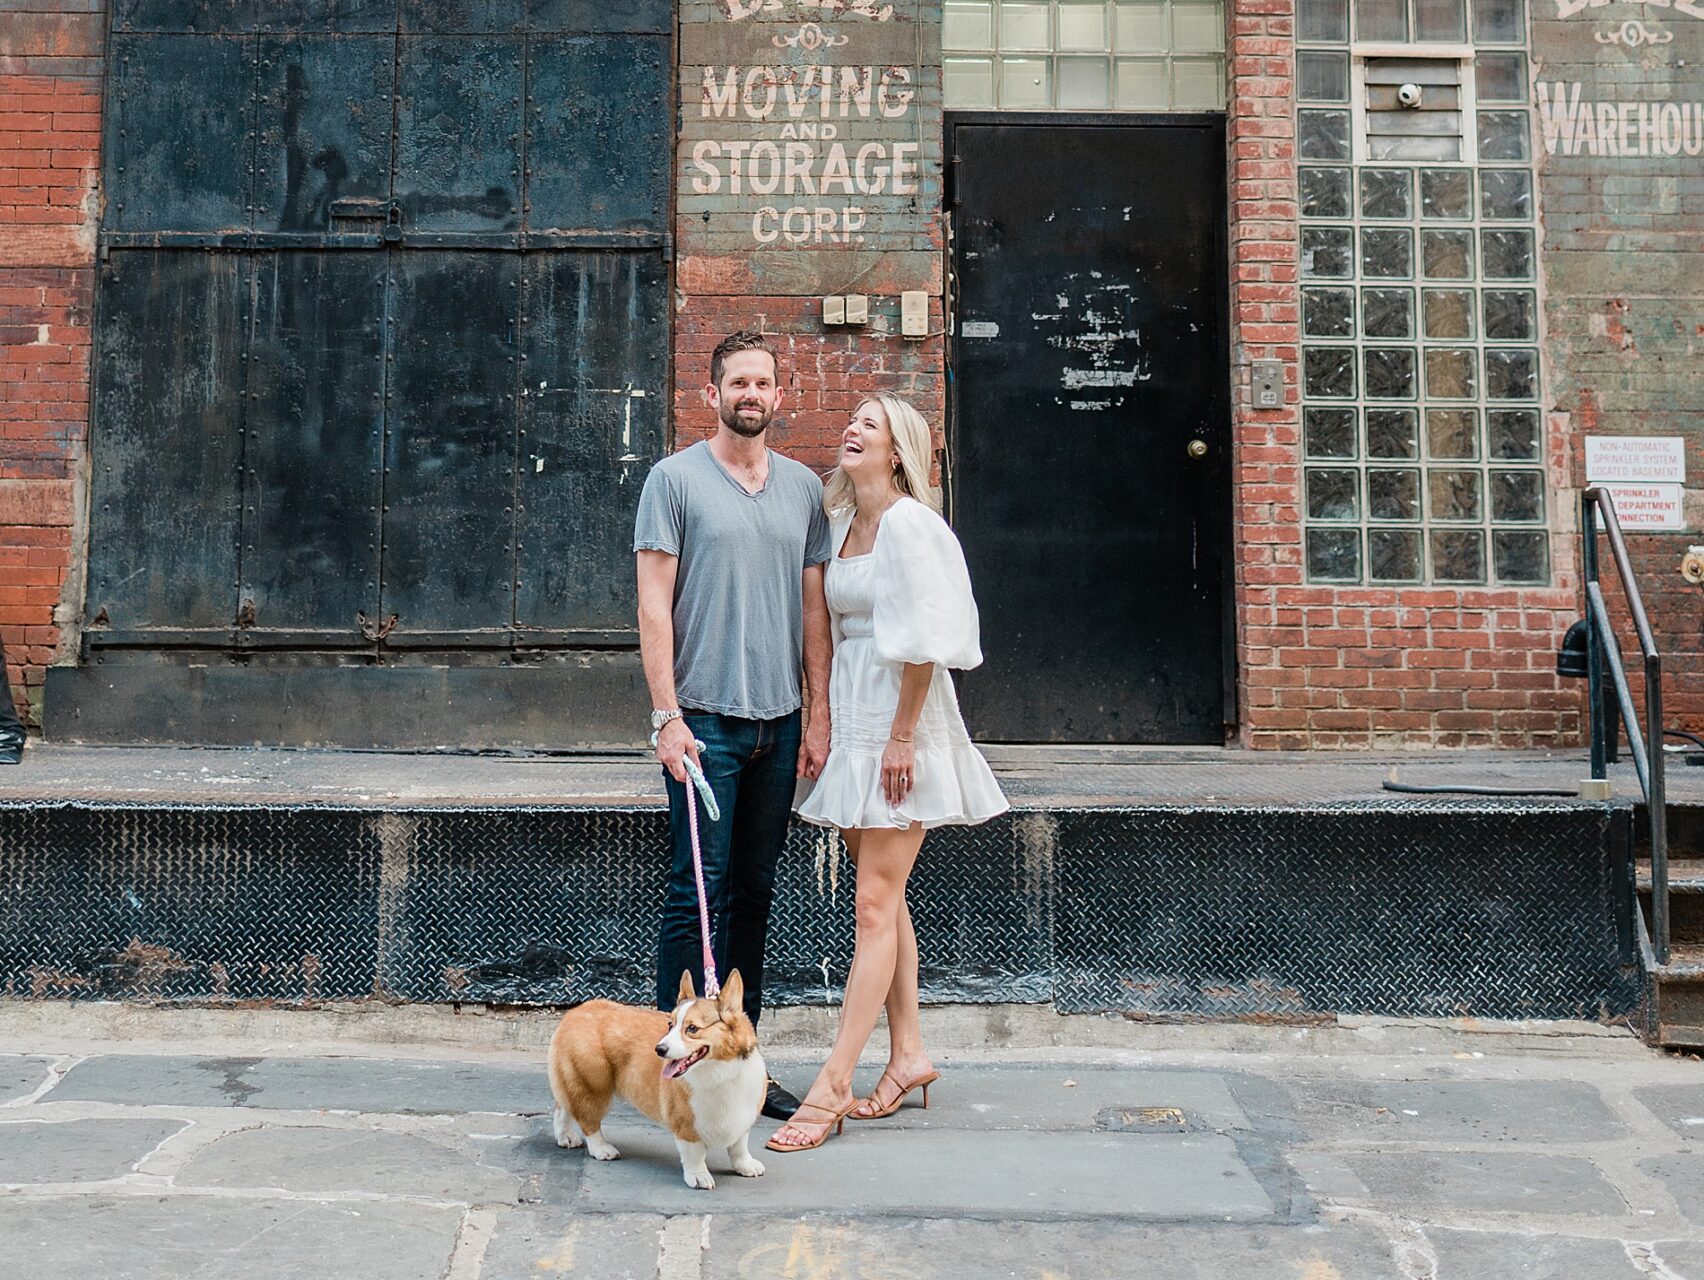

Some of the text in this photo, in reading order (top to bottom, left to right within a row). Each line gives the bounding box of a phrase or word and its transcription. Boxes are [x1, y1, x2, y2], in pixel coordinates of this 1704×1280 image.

[701, 65, 915, 118] MOVING
[779, 123, 839, 140] AND
[691, 141, 919, 195] STORAGE
[752, 206, 866, 244] CORP.
[1599, 441, 1671, 452] NON-AUTOMATIC
[1593, 454, 1677, 465] SPRINKLER SYSTEM
[1592, 466, 1678, 477] LOCATED BASEMENT
[1612, 489, 1660, 498] SPRINKLER
[1618, 501, 1676, 510] DEPARTMENT
[1616, 513, 1664, 523] ONNECTION
